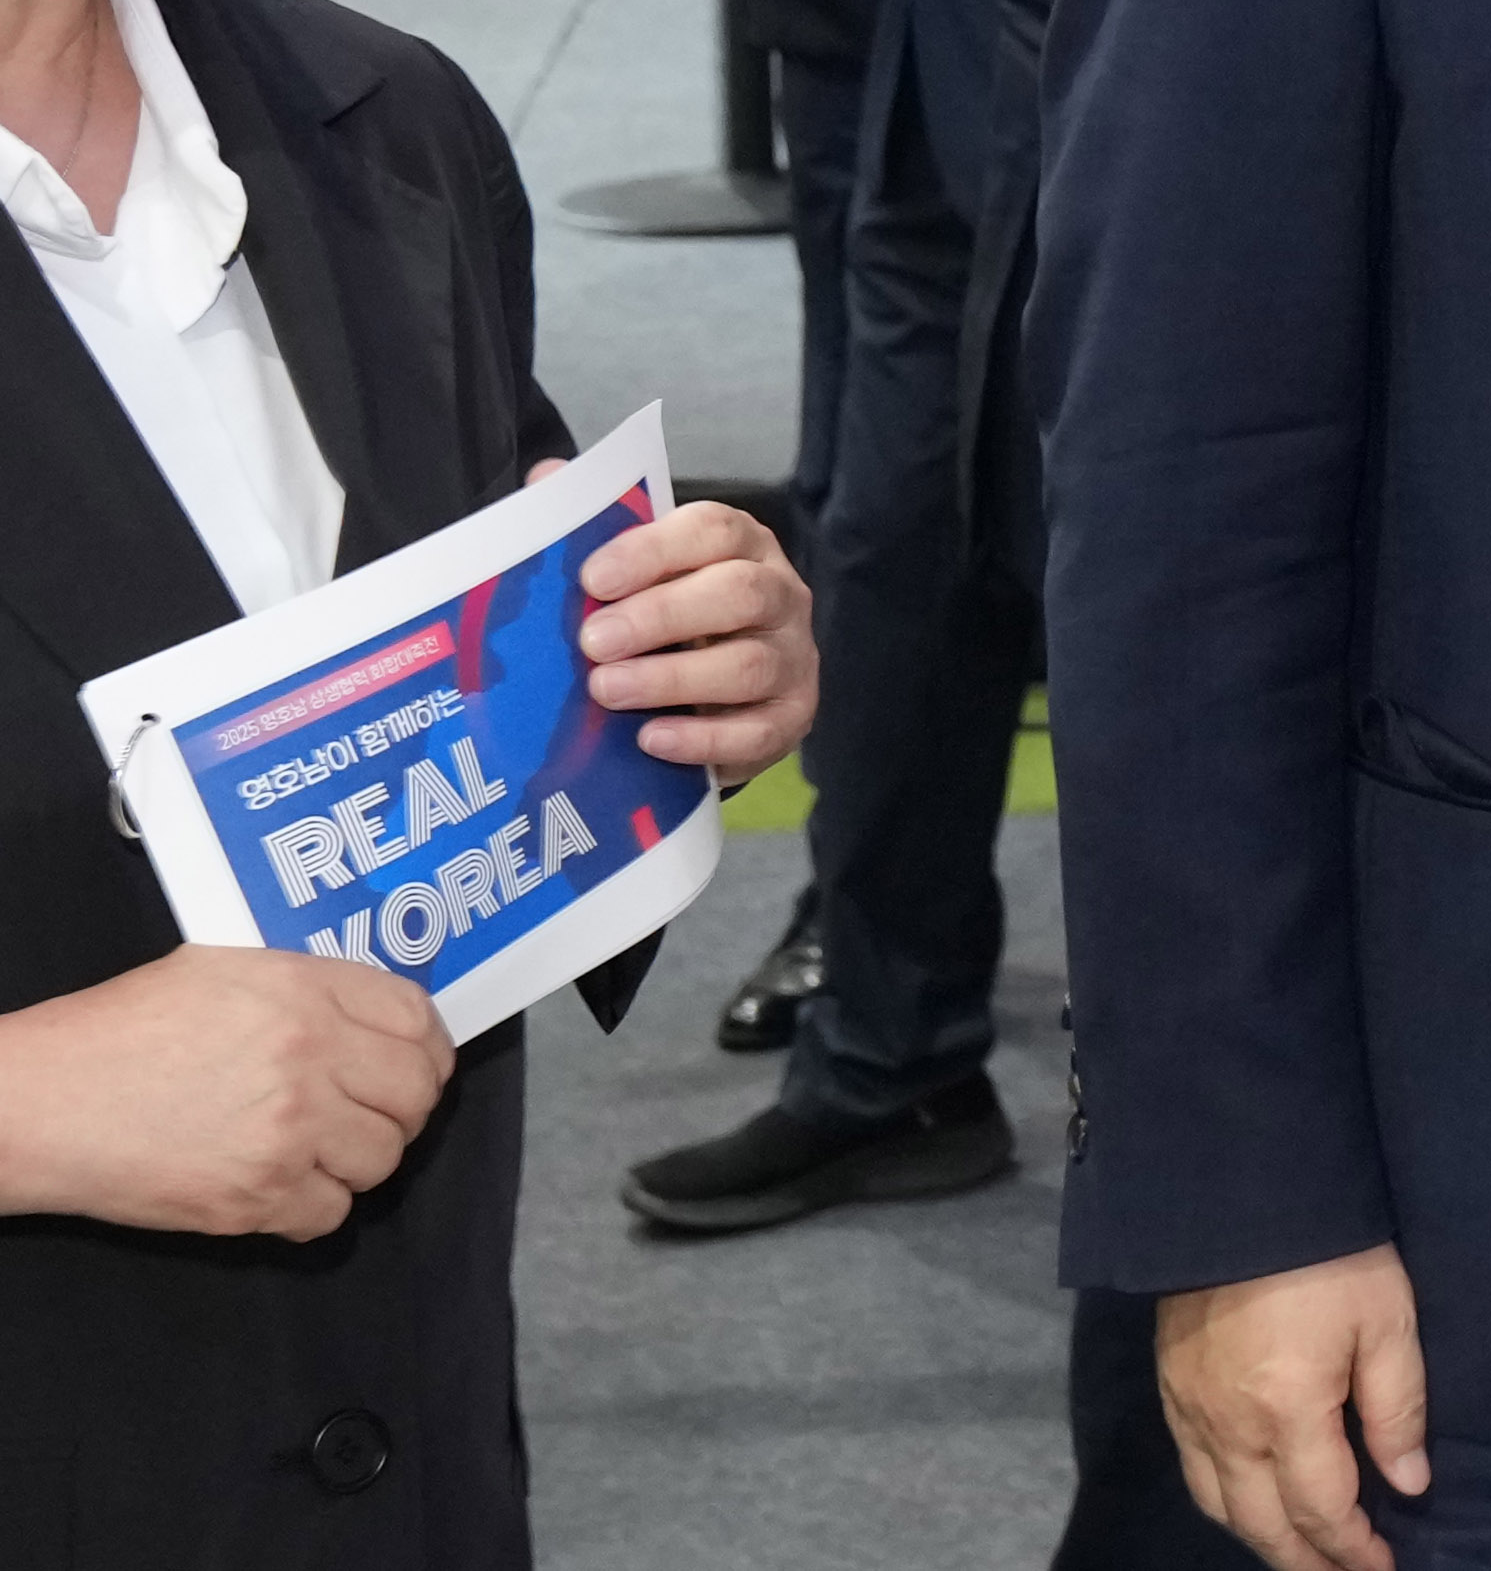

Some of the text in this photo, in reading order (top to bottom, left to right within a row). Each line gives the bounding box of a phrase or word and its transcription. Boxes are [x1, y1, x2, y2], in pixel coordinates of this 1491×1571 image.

[217, 634, 441, 751] 2025 영호남 상생협력 화합대축전
[236, 687, 465, 811] 영호남이 함께하는
[259, 735, 508, 909] REAL
[305, 789, 599, 974] KOREA
